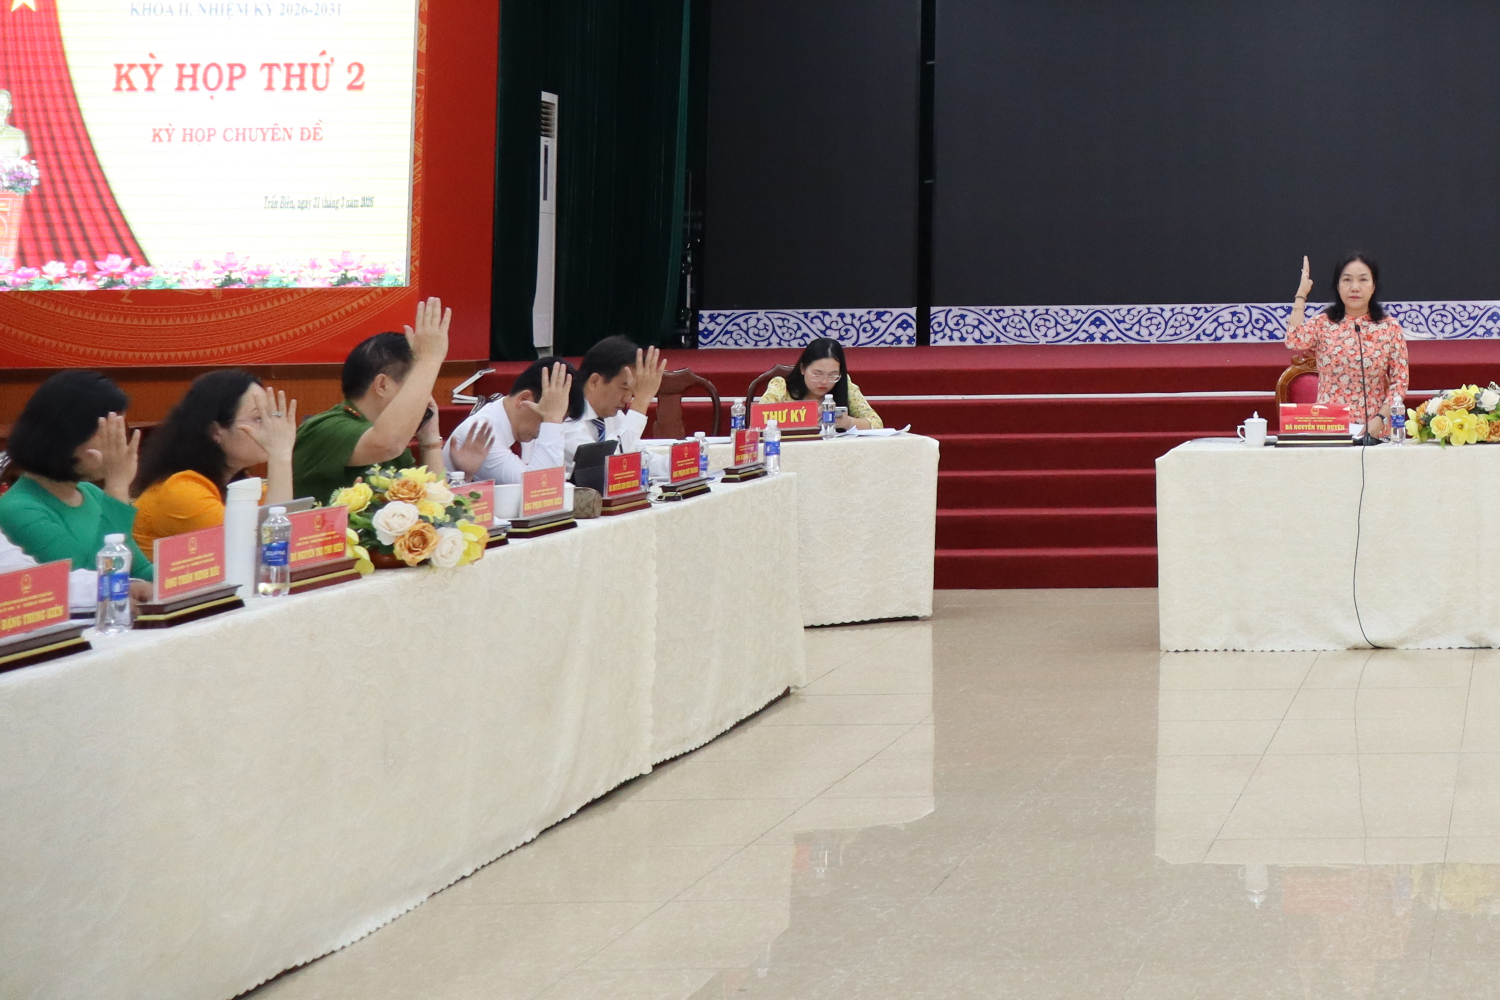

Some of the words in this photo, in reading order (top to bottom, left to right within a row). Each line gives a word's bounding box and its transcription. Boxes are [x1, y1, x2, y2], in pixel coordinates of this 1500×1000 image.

[279, 2, 342, 16] 2026-2031
[113, 52, 164, 92] KỲ
[174, 62, 248, 100] HỌP
[259, 50, 335, 91] THỨ
[346, 61, 366, 90] 2
[151, 123, 176, 143] KỲ
[181, 127, 217, 146] HỌP
[222, 123, 294, 142] CHUYÊN
[299, 119, 324, 142] ĐỀ
[790, 406, 807, 423] KÝ
